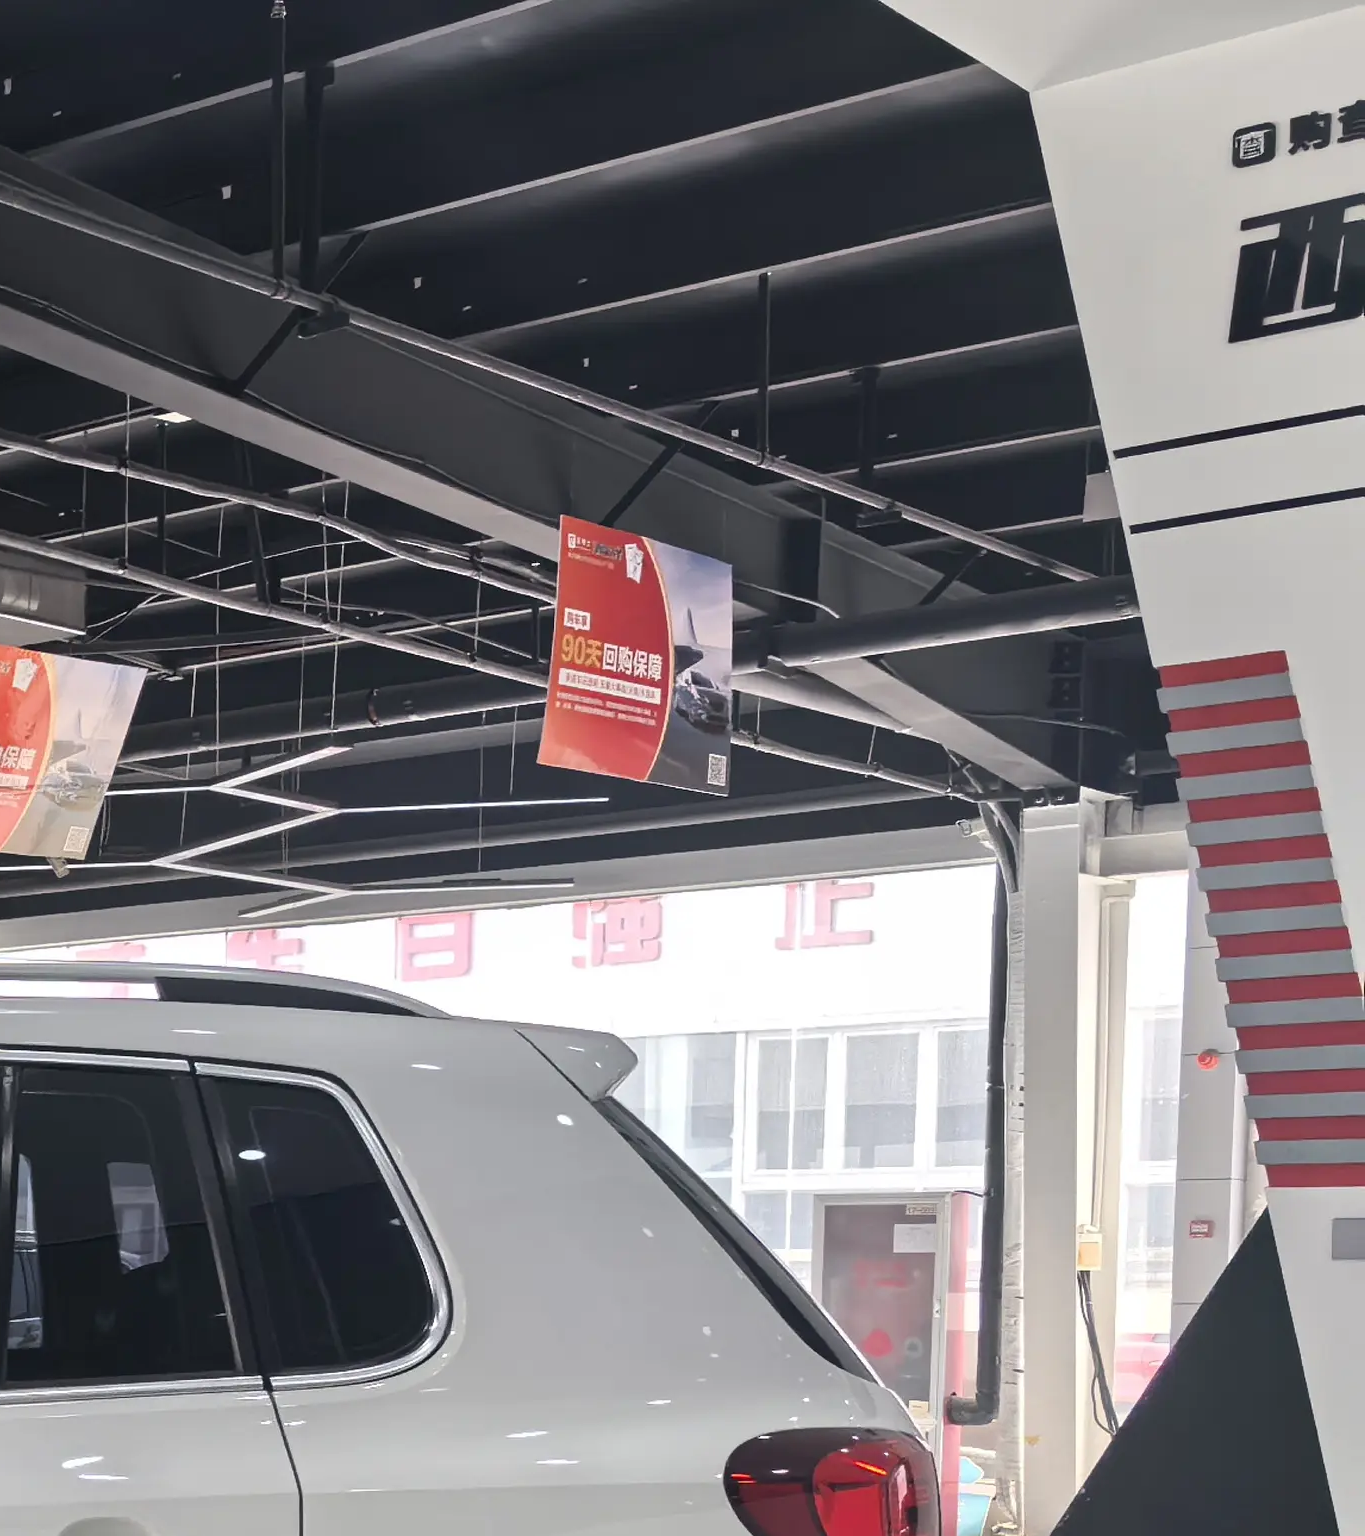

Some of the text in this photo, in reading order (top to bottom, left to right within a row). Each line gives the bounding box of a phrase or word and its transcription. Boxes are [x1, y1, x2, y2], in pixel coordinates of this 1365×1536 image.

[561, 633, 663, 681] 90天回购保障
